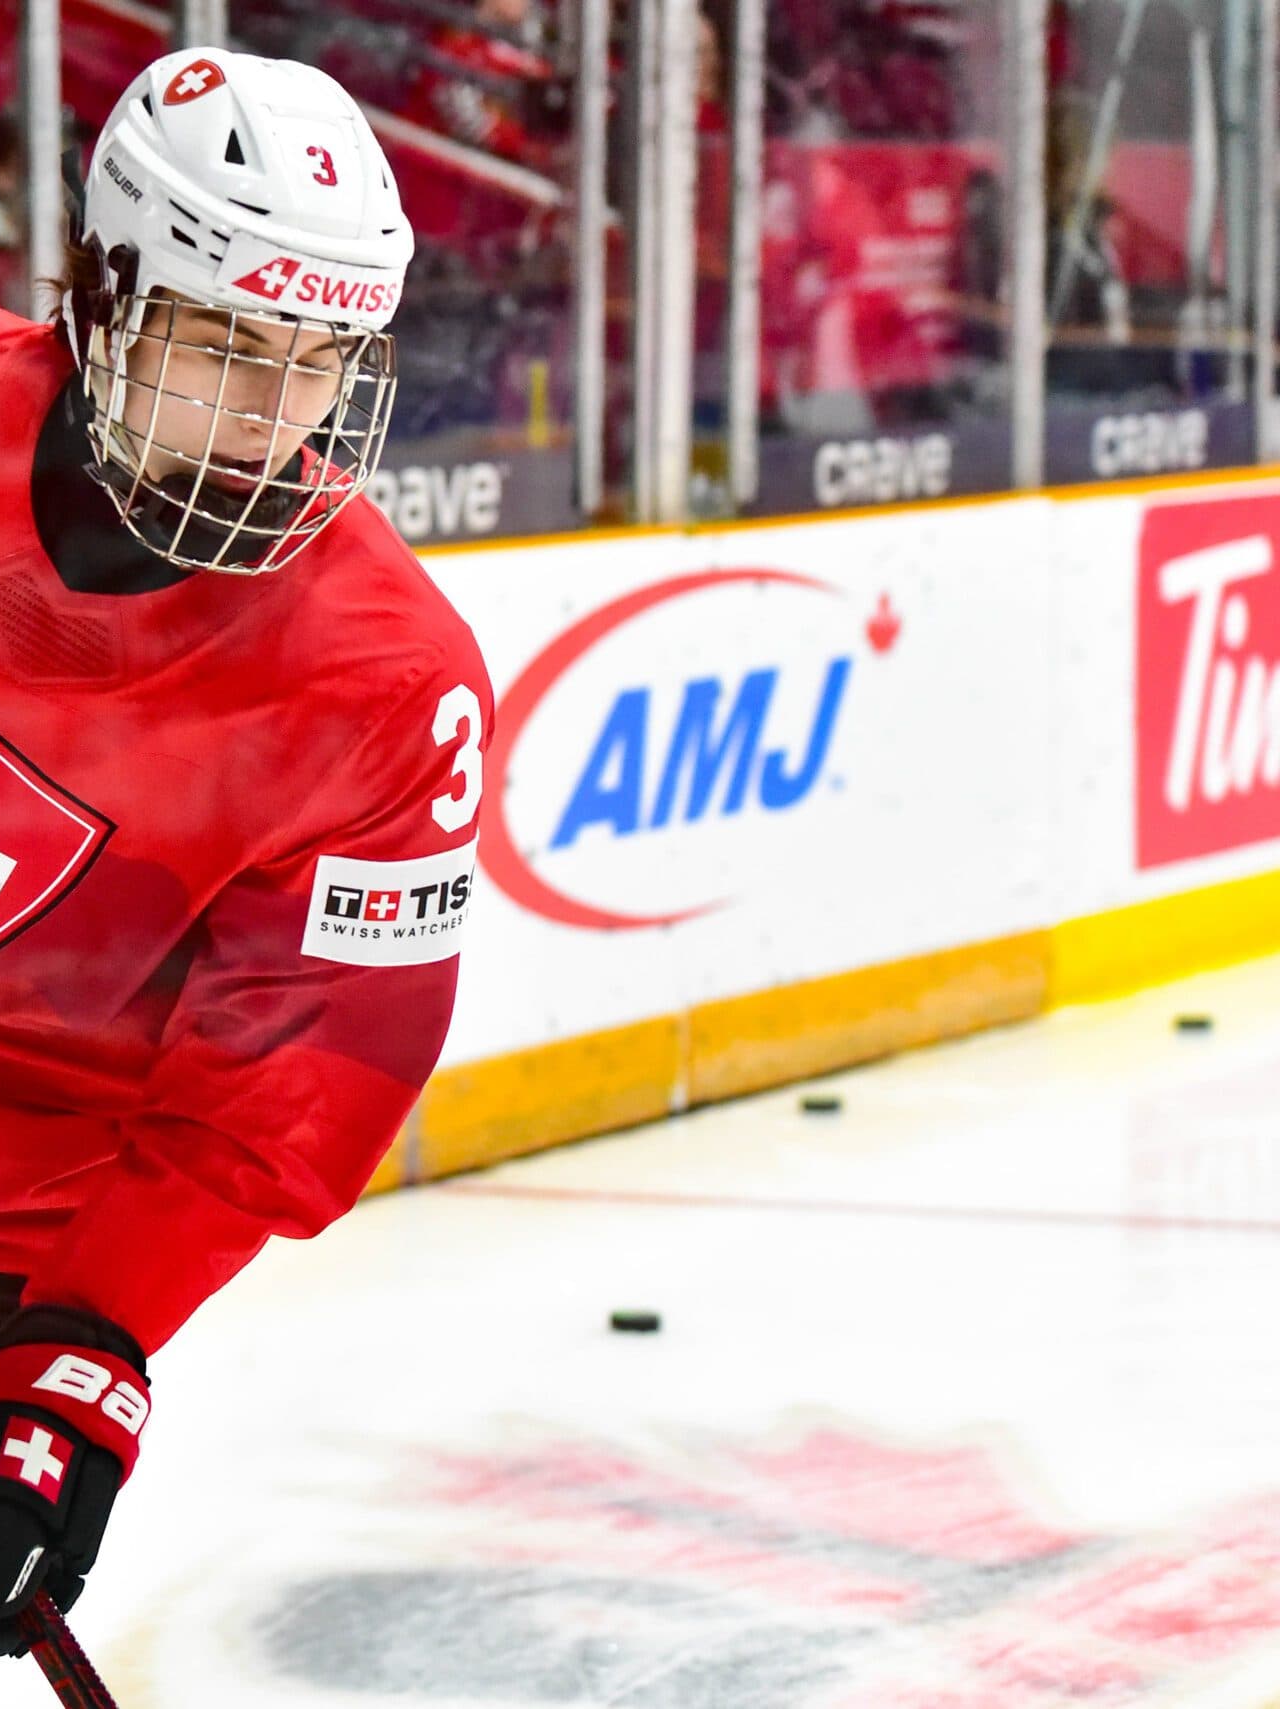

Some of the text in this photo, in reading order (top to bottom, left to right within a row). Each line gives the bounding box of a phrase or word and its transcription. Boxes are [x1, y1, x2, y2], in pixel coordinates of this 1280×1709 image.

[306, 146, 338, 187] 3
[295, 273, 398, 312] SWISS
[431, 683, 483, 833] 3
[548, 658, 851, 850] AMJ
[410, 864, 477, 919] TIS
[320, 914, 463, 938] SWISS WATCHES
